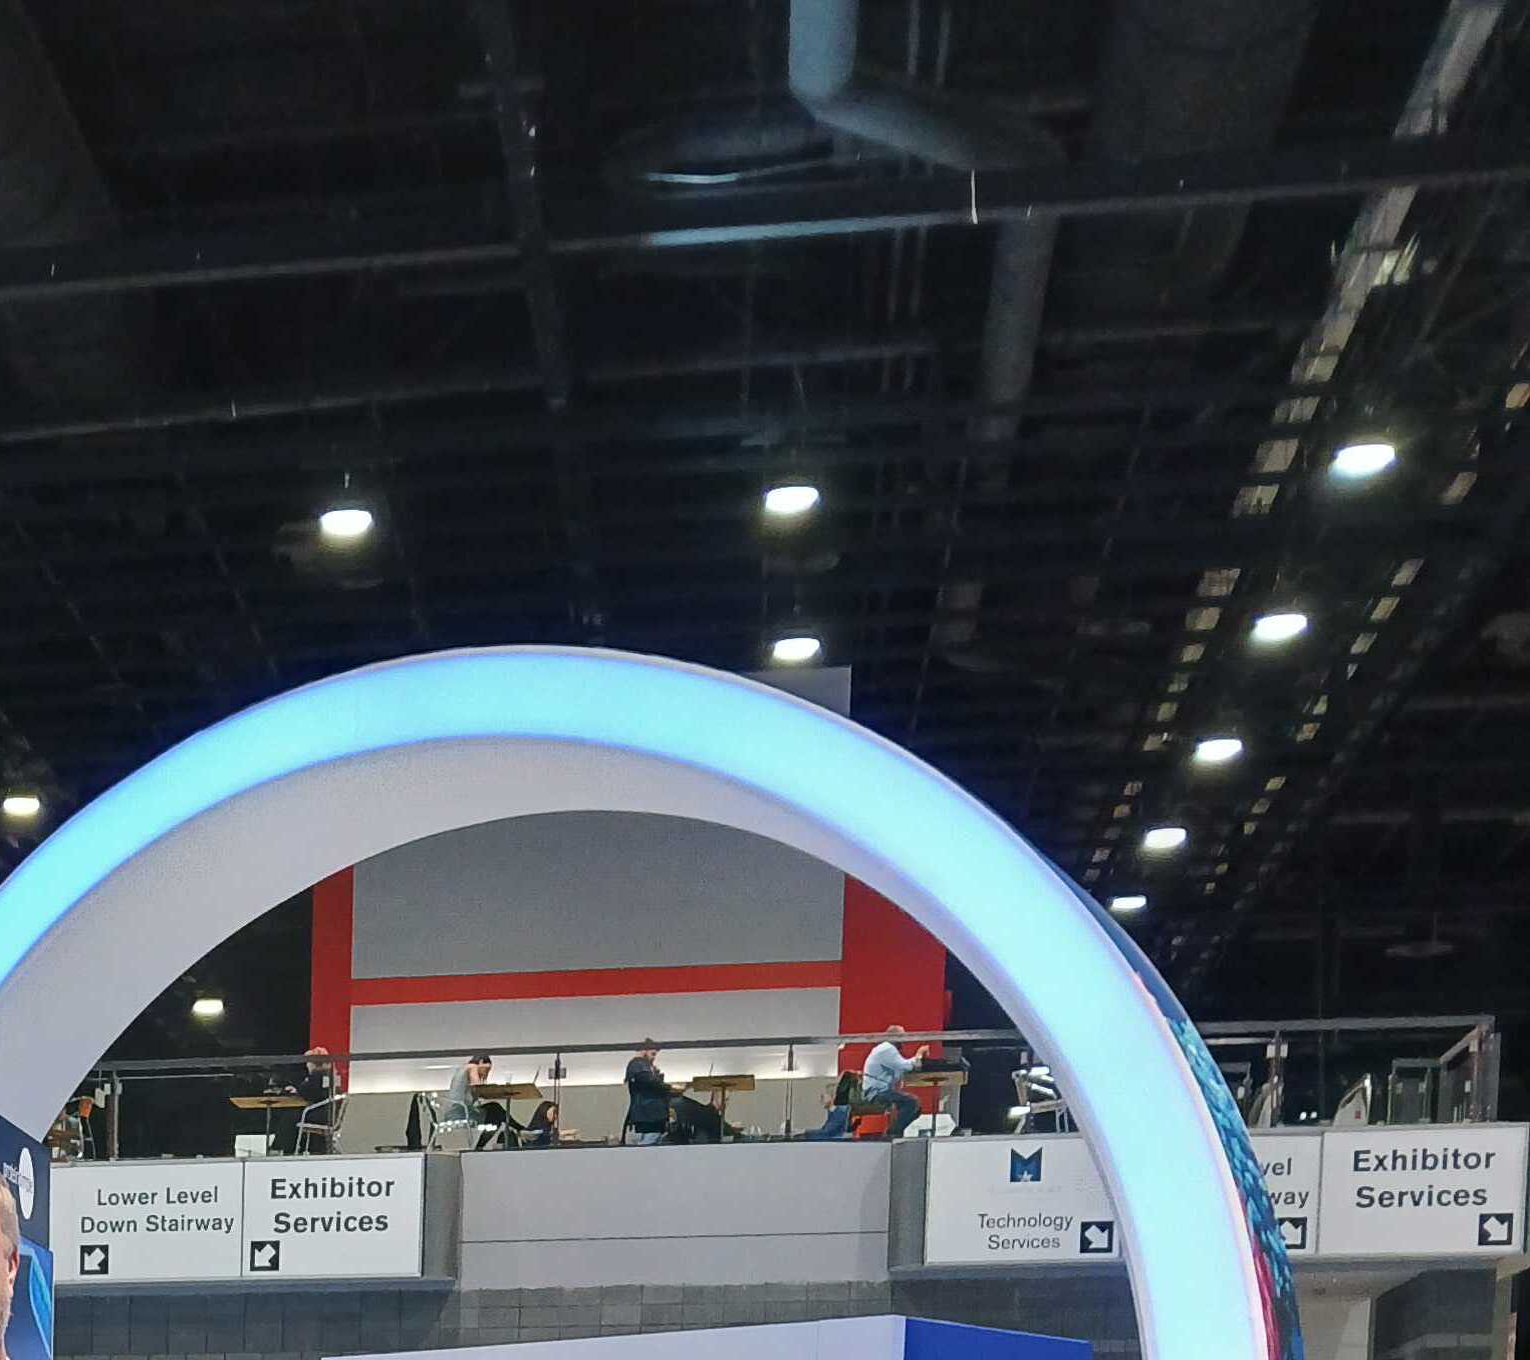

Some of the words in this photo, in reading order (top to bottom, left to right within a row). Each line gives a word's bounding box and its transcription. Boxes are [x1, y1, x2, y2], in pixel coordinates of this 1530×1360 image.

[1261, 1157, 1293, 1176] vel
[1352, 1147, 1496, 1172] Exhibitor
[97, 1188, 158, 1207] Lower
[166, 1185, 219, 1205] Level
[270, 1176, 396, 1200] Exhibitor
[1355, 1184, 1488, 1208] Services
[80, 1216, 138, 1235] Down
[146, 1213, 235, 1234] Stairway
[273, 1210, 389, 1235] Services
[977, 1212, 1074, 1232] Technology
[988, 1233, 1061, 1250] Services
